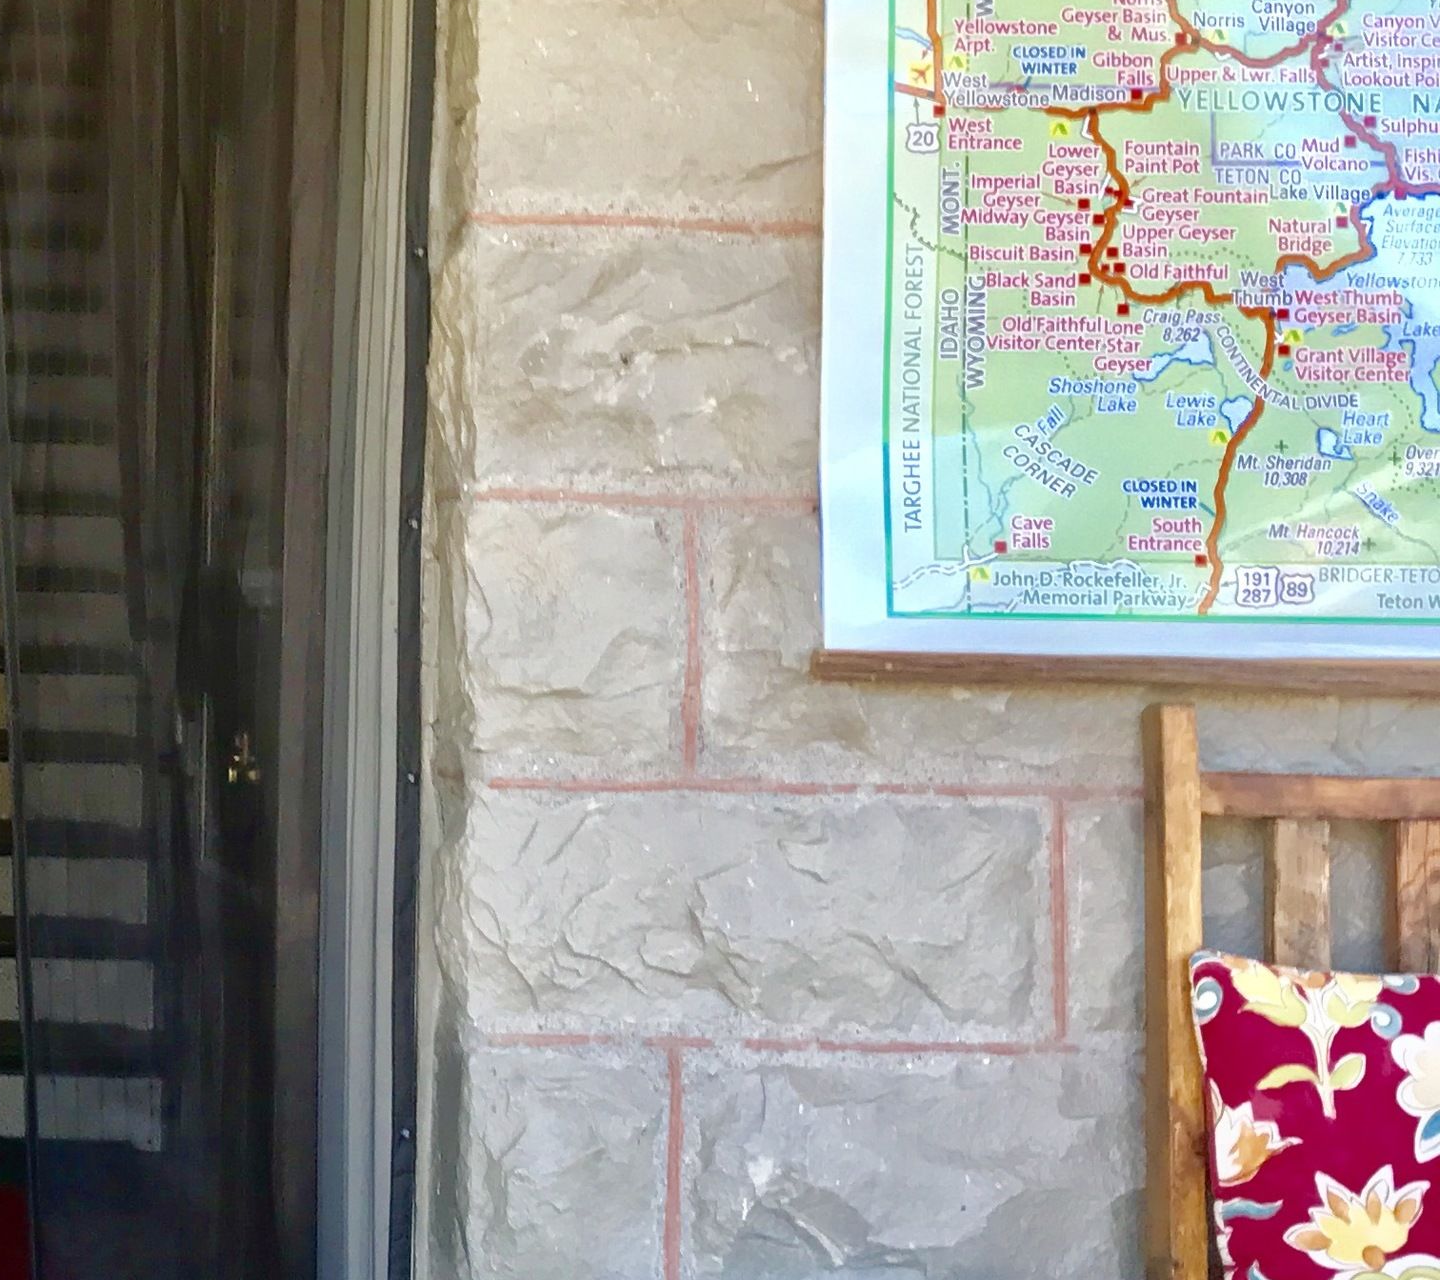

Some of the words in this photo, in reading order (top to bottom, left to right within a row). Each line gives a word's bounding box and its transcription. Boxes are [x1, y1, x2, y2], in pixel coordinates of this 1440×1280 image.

[1252, 0, 1315, 17] Canyon
[1061, 8, 1118, 26] Geyser
[1123, 9, 1167, 24] Basin
[1193, 12, 1245, 28] Norris
[954, 19, 1058, 35] Yellowstone
[1259, 17, 1316, 36] Village
[1013, 46, 1066, 59] CLOSED
[1070, 47, 1086, 59] IN
[1092, 53, 1153, 68] Gibbon
[1022, 62, 1077, 75] WINTER
[944, 73, 987, 87] West
[1117, 71, 1154, 86] Falls
[1167, 70, 1217, 85] Upper
[1280, 69, 1315, 83] Falls
[945, 90, 1049, 107] Yellowstone
[1052, 86, 1126, 102] Madison
[1177, 89, 1382, 113] YELLOWSTONE
[949, 118, 992, 133] West
[913, 131, 935, 147] 20
[948, 135, 1023, 150] Entrance
[1302, 138, 1340, 153] Mud
[1048, 144, 1100, 159] Lower
[1125, 141, 1200, 157] Fountain
[1220, 143, 1264, 159] PARK
[1042, 162, 1099, 180] Geyser
[1125, 159, 1167, 174] Paint
[1172, 159, 1200, 174] Pot
[1302, 156, 1369, 170] Volcano
[971, 174, 1040, 193] Imperial
[1215, 169, 1269, 184] TETON
[1054, 179, 1099, 195] Basin
[1269, 184, 1308, 200] Lake
[1313, 184, 1371, 205] Village
[984, 193, 1041, 210] Geyser
[1142, 188, 1189, 203] Great
[1194, 188, 1268, 204] Fountain
[960, 209, 1029, 228] Midway
[1034, 210, 1090, 228] Geyser
[1142, 207, 1199, 224] Geyser
[1045, 227, 1090, 241] Basin
[1122, 225, 1174, 244] Upper
[1179, 226, 1236, 244] Geyser
[1269, 219, 1332, 234] Natural
[970, 246, 1026, 261] Biscuit
[1030, 246, 1074, 261] Basin
[1123, 243, 1168, 257] Basin
[1278, 237, 1332, 255] Bridge
[986, 272, 1030, 287] Black
[1034, 273, 1076, 288] Sand
[1130, 264, 1160, 280] Old
[1164, 264, 1228, 280] Faithful
[1241, 272, 1284, 288] West
[904, 243, 923, 320] FOREST
[1030, 291, 1075, 306] Basin
[1232, 289, 1293, 306] Thumb
[1295, 290, 1338, 305] West
[1344, 290, 1403, 305] Thumb
[940, 289, 959, 359] IDAHO
[1003, 318, 1033, 332] Old
[1036, 318, 1102, 333] Faithful
[1294, 308, 1351, 327] Geyser
[1356, 308, 1402, 324] Basin
[967, 275, 986, 389] WYOMING
[1104, 320, 1144, 335] Lone
[986, 335, 1041, 351] Visitor
[1045, 336, 1101, 351] Center
[1107, 337, 1141, 352] Star
[1094, 357, 1153, 375] Geyser
[1216, 322, 1300, 410] CONTINENTAL
[1306, 394, 1358, 408] DIVIDE
[1295, 348, 1344, 363] Grant
[1349, 348, 1406, 368] Village
[903, 325, 922, 432] NATIONAL
[1295, 366, 1351, 381] Visitor
[1356, 367, 1410, 382] Center
[1049, 377, 1137, 394] Shoshone
[1097, 397, 1137, 412] Lake
[1166, 392, 1216, 408] Lewis
[1036, 406, 1064, 436] Fall
[1177, 411, 1217, 427] Lake
[1342, 411, 1389, 427] Heart
[1343, 430, 1382, 444] Lake
[1014, 424, 1098, 485] CASCADE
[1266, 454, 1331, 470] Sheridan
[1003, 446, 1077, 499] CORNER
[1263, 471, 1308, 487] 10,308
[903, 440, 922, 533] TARGHEE
[1122, 480, 1178, 493] CLOSED
[1182, 480, 1197, 493] IN
[1140, 496, 1197, 509] WINTER
[1356, 482, 1400, 524] Snake
[1011, 515, 1054, 531] Cave
[1153, 518, 1202, 533] South
[1296, 524, 1359, 539] Hancock
[1012, 532, 1050, 549] Falls
[1128, 536, 1202, 552] Entrance
[993, 572, 1034, 587] John
[1243, 572, 1270, 587] 191
[1242, 588, 1271, 604] 287
[1286, 582, 1307, 597] 89
[1023, 590, 1108, 605] Memorial
[1113, 590, 1187, 608] Parkway
[1377, 593, 1424, 609] Teton
